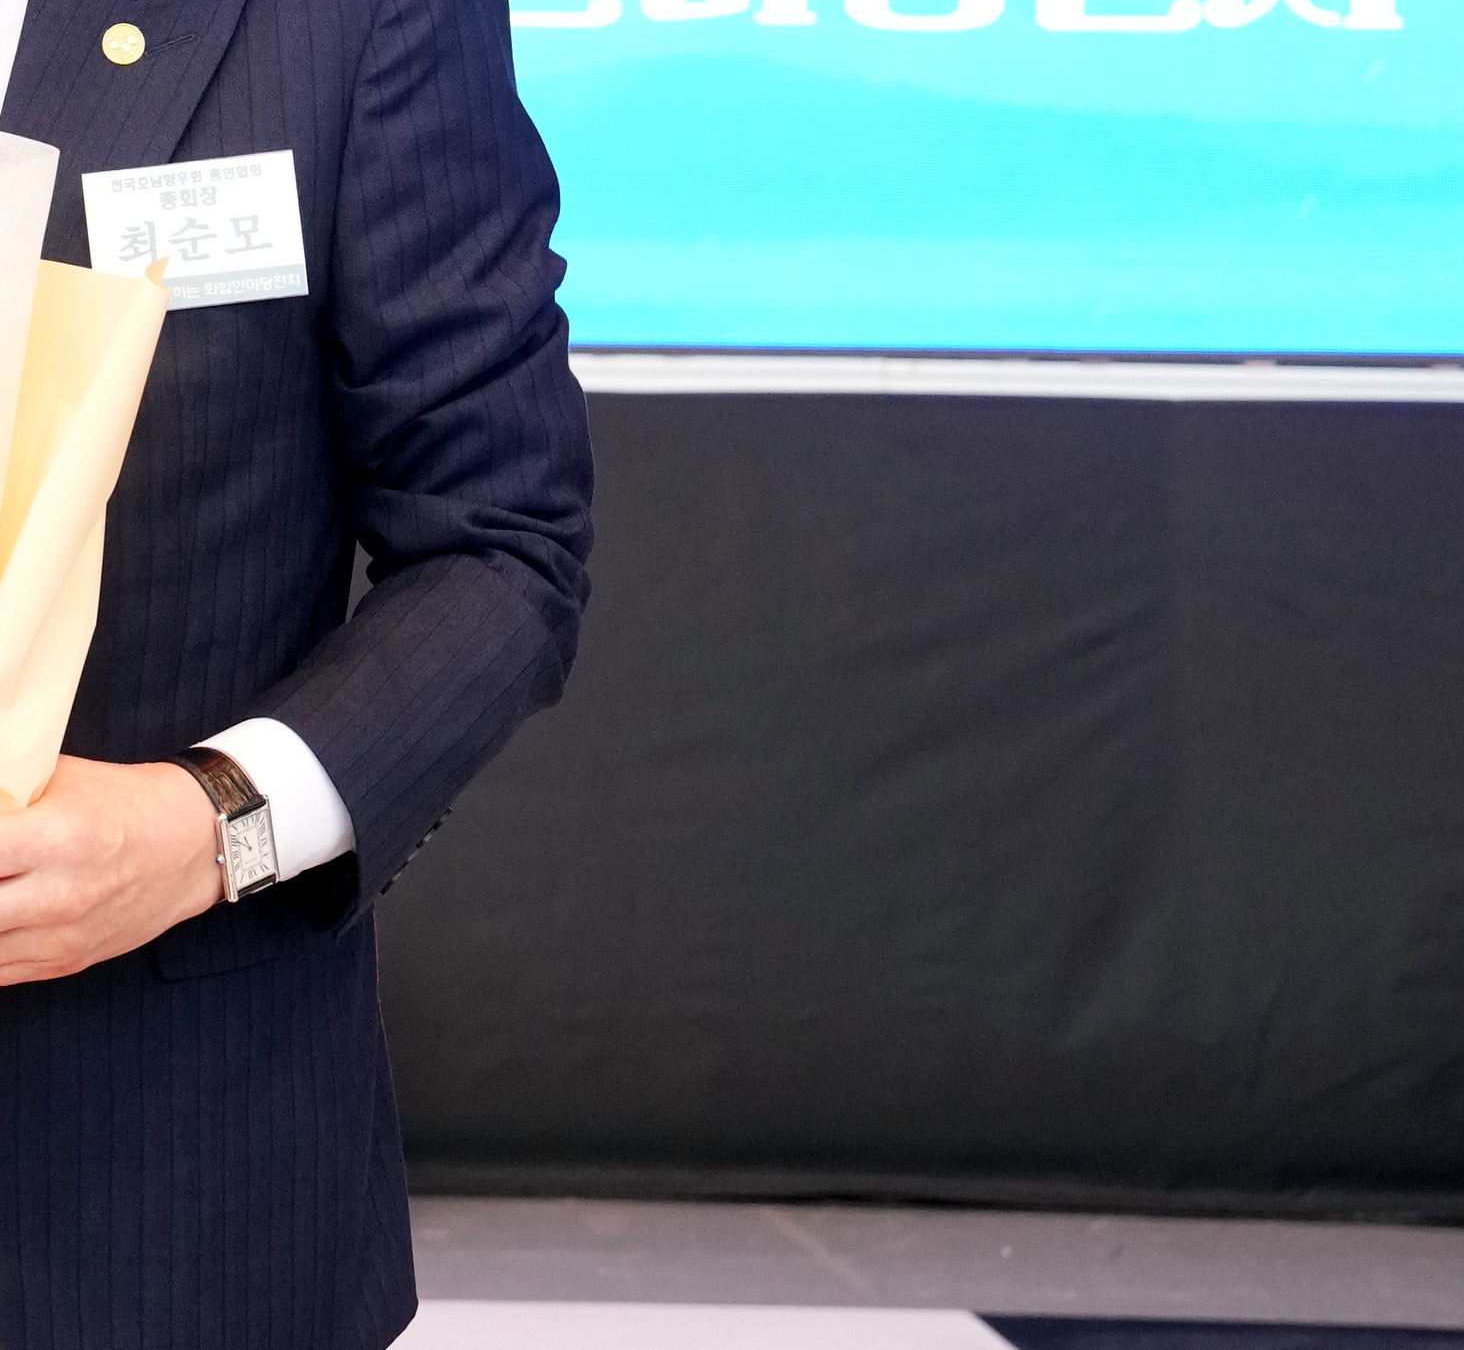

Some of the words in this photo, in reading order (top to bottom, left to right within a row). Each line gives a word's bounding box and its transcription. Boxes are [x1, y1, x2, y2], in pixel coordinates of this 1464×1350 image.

[111, 170, 203, 193] 전국호남향우회
[159, 185, 218, 210] 총회장
[118, 214, 273, 263] 최순모
[204, 273, 301, 296] 화합한마당잔치
